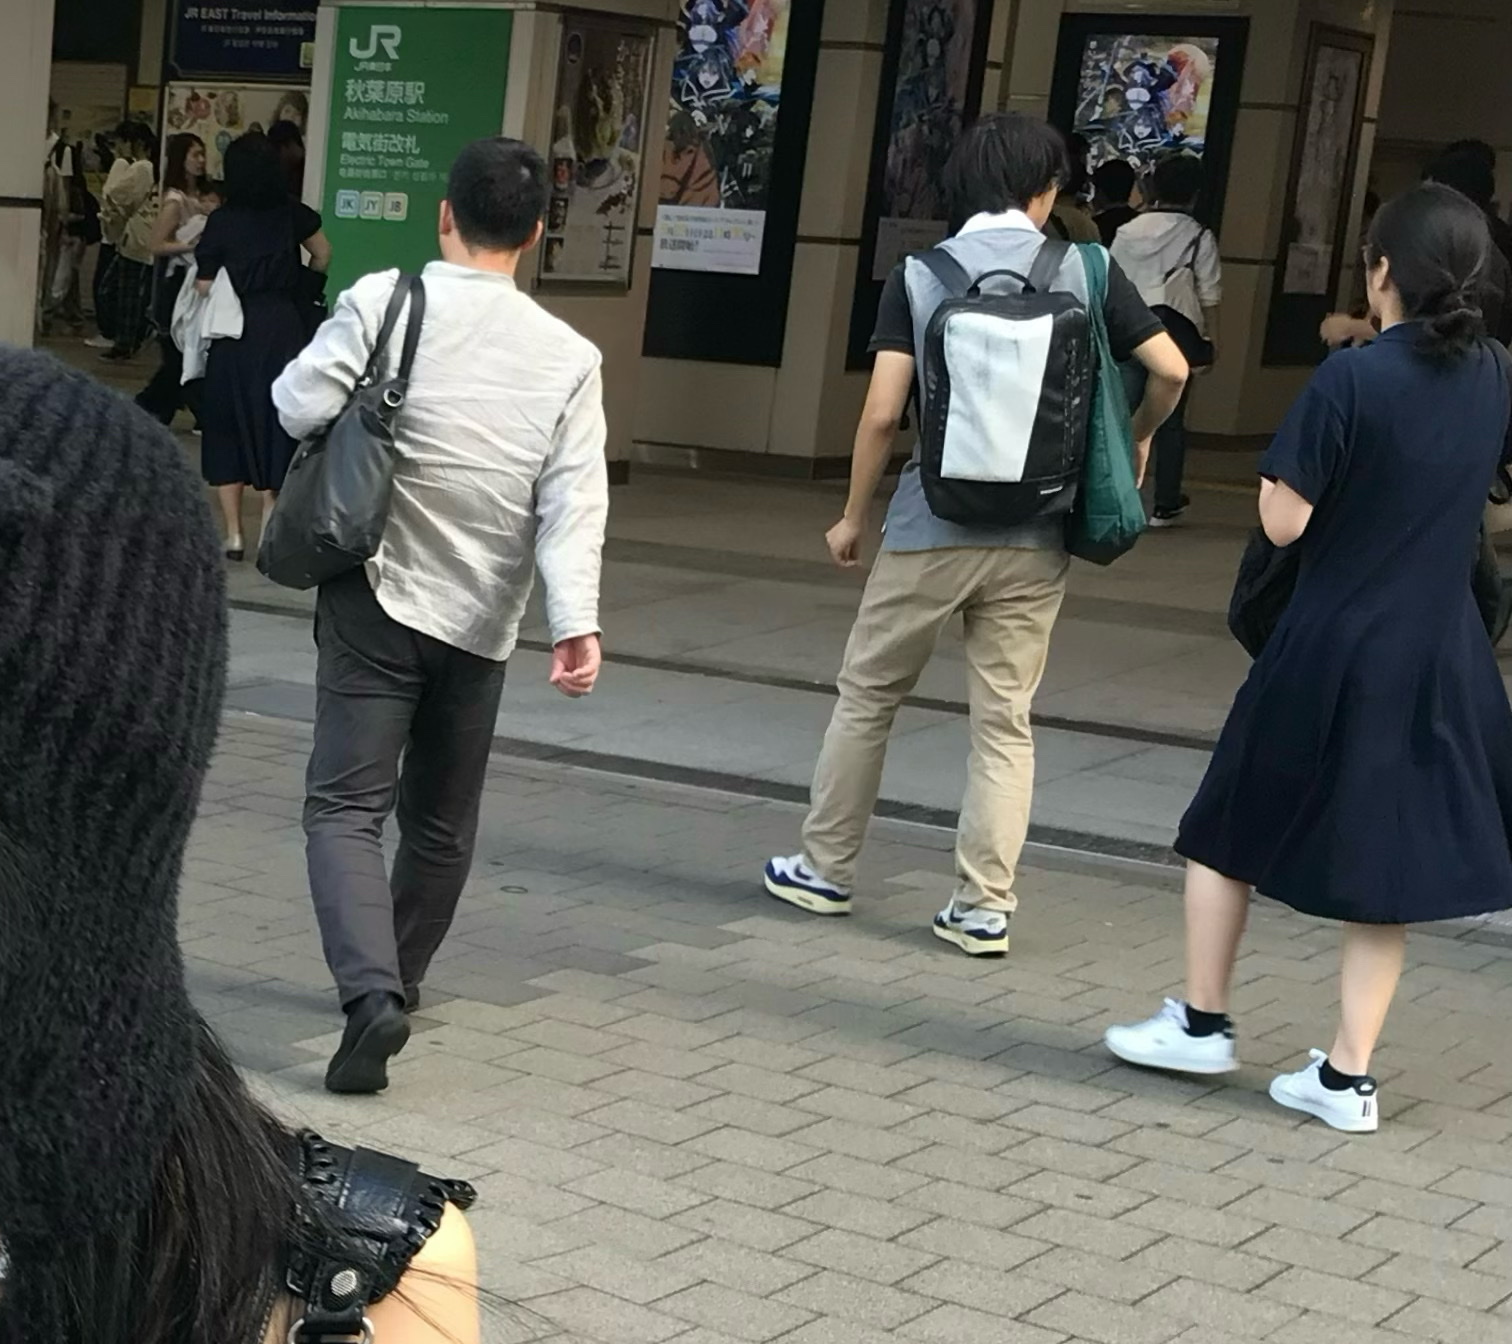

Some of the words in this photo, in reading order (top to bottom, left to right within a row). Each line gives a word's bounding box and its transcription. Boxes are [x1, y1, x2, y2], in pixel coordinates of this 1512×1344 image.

[200, 7, 230, 20] EAST
[263, 9, 316, 23] Informatio
[349, 24, 402, 60] JR
[345, 78, 426, 105] 秋葉原駅
[343, 106, 405, 123] Akihabara
[406, 108, 449, 124] Station
[341, 131, 421, 155] 電気街改札
